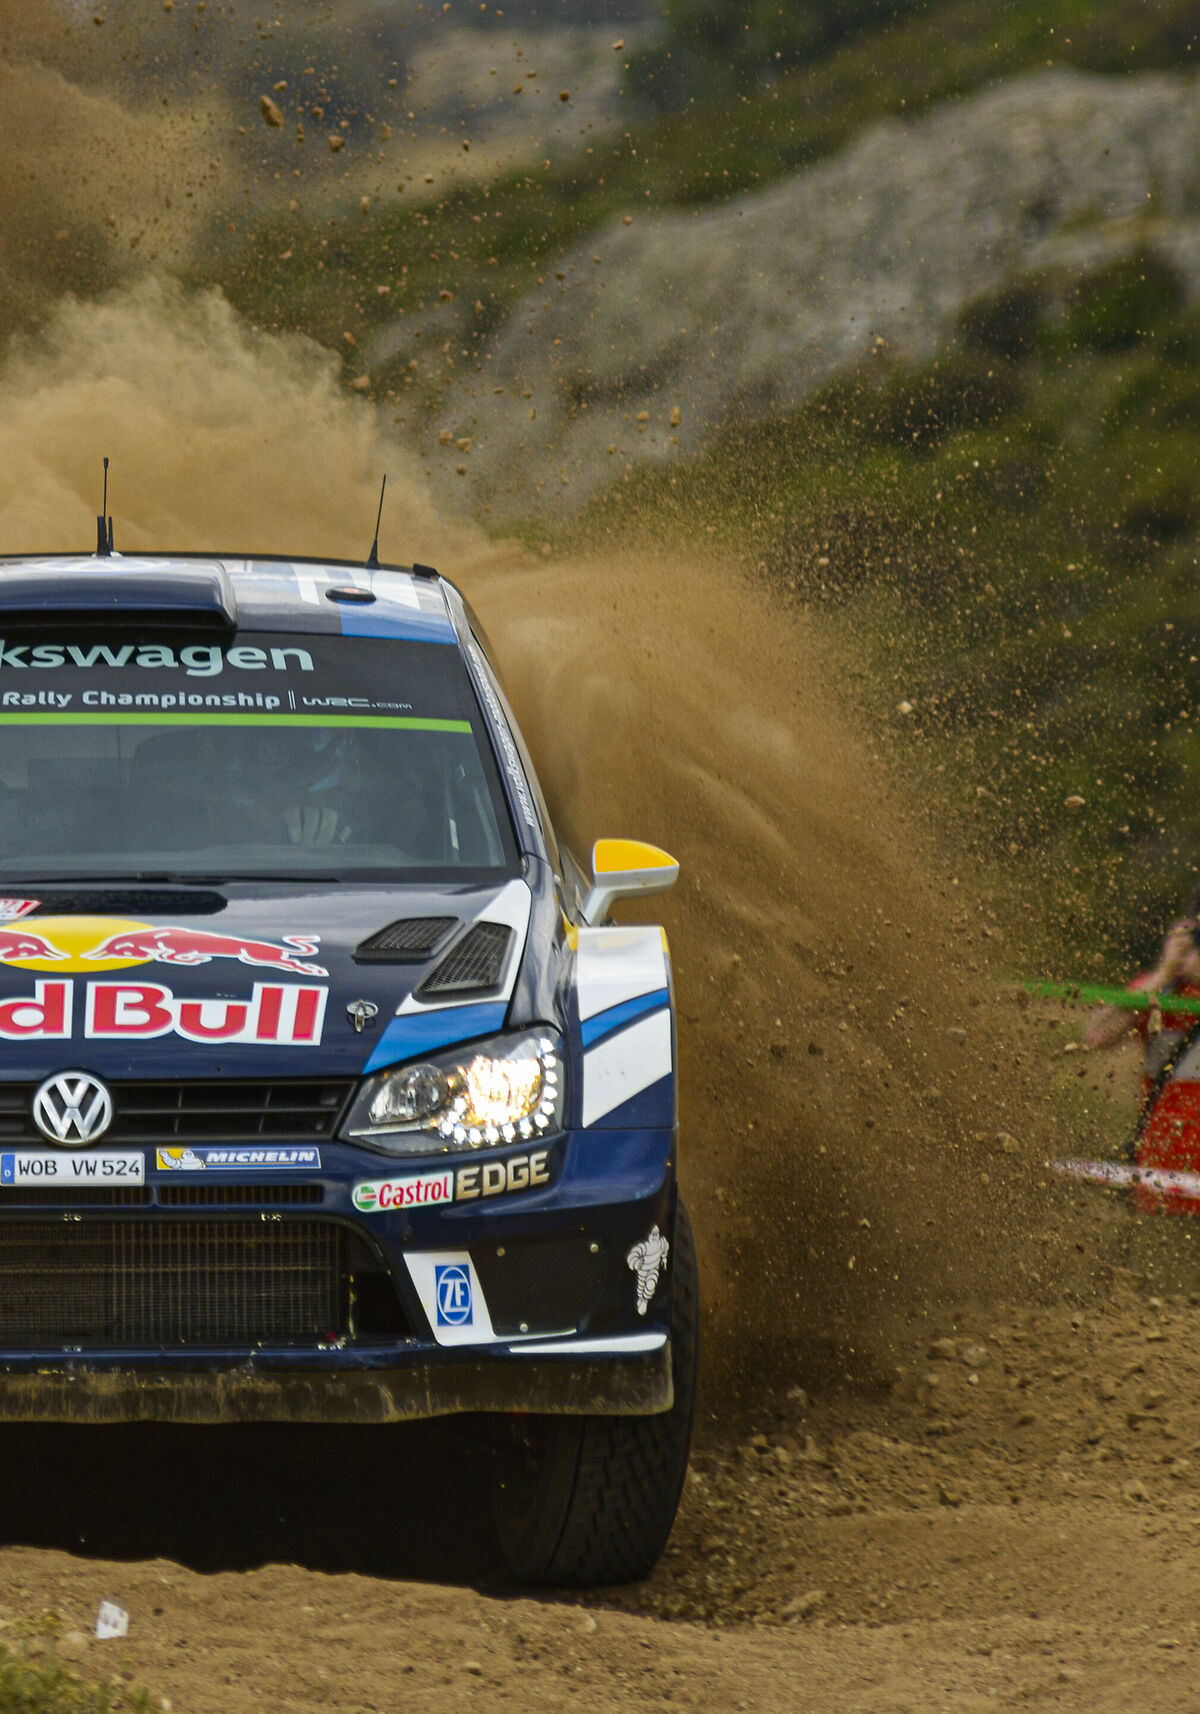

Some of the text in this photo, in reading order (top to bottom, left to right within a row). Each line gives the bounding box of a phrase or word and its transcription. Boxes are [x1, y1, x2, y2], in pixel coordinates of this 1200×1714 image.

[2, 690, 72, 708] Rally
[81, 690, 281, 710] Championship
[90, 983, 324, 1044] Bull
[17, 1159, 59, 1177] WOB
[205, 1149, 317, 1164] MICHELIN
[379, 1151, 550, 1209] Castrol EDGE
[440, 1278, 469, 1313] ZF
